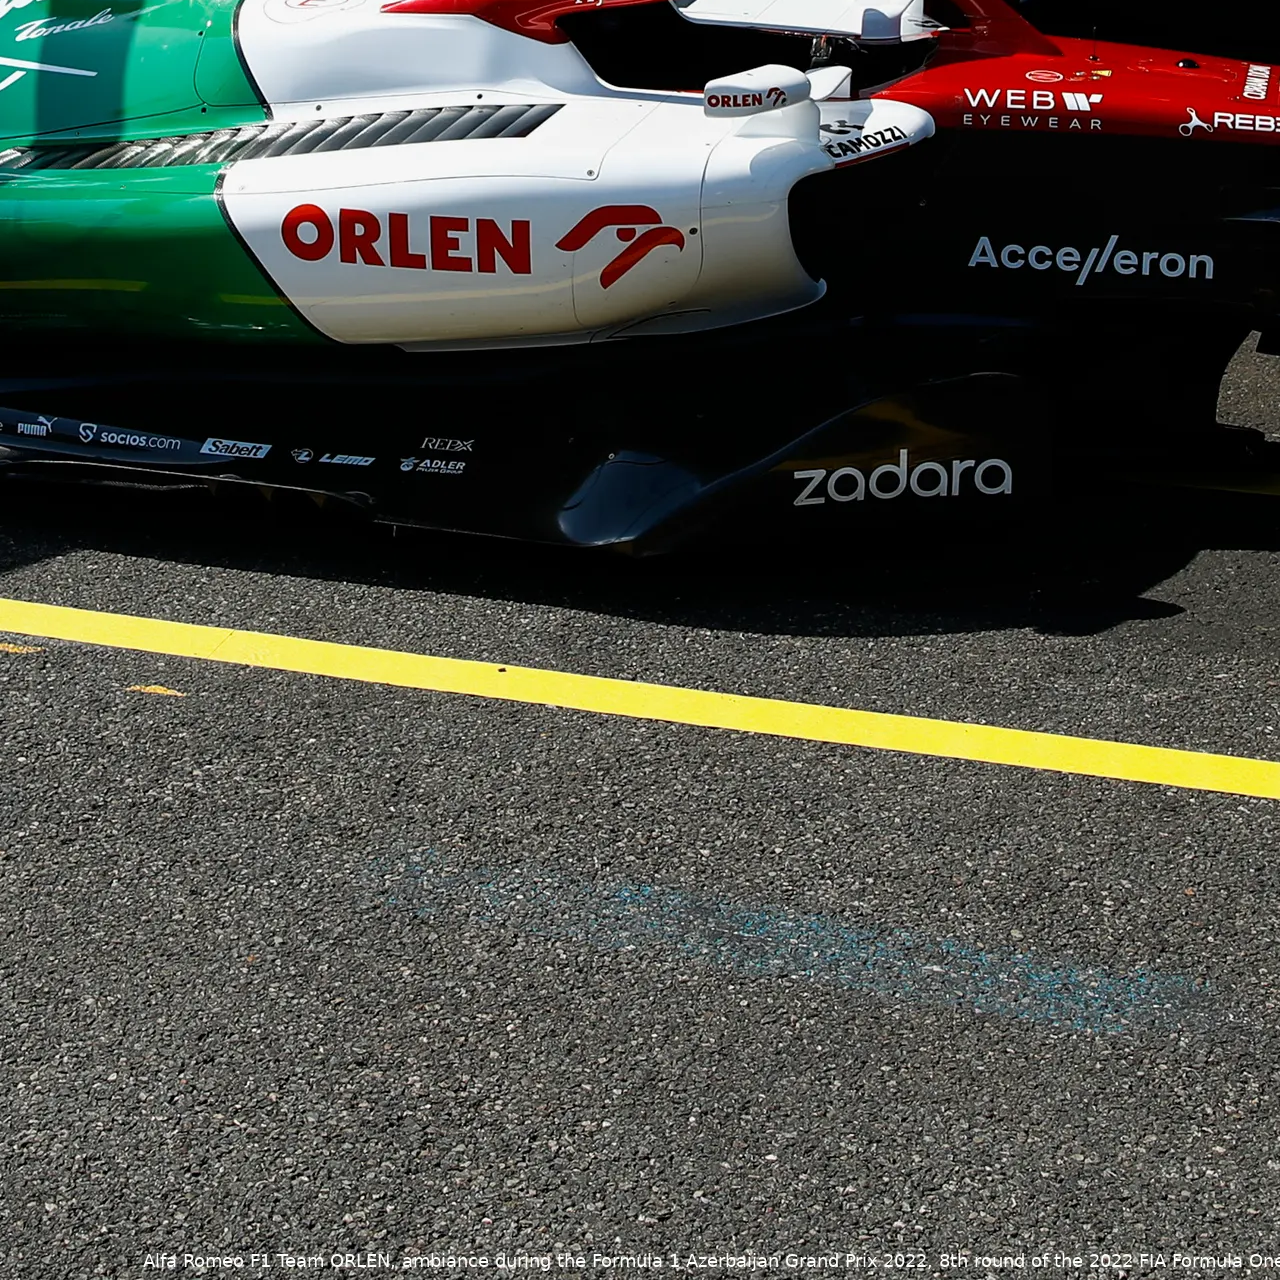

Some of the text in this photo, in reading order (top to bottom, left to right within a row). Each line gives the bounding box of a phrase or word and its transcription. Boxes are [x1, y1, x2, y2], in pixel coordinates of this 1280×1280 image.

[15, 8, 114, 42] Tonale
[707, 94, 763, 108] ORLEN
[963, 87, 1056, 111] WEB
[963, 113, 1102, 131] EYEWEAR
[826, 125, 908, 159] CAMOZZI
[281, 204, 531, 275] ORLEN
[17, 423, 47, 436] PUMA
[100, 430, 181, 450] socios.com
[207, 439, 264, 458] Sabelt
[319, 453, 376, 466] LEMO
[419, 459, 466, 471] ADLER
[793, 448, 1013, 506] zadara
